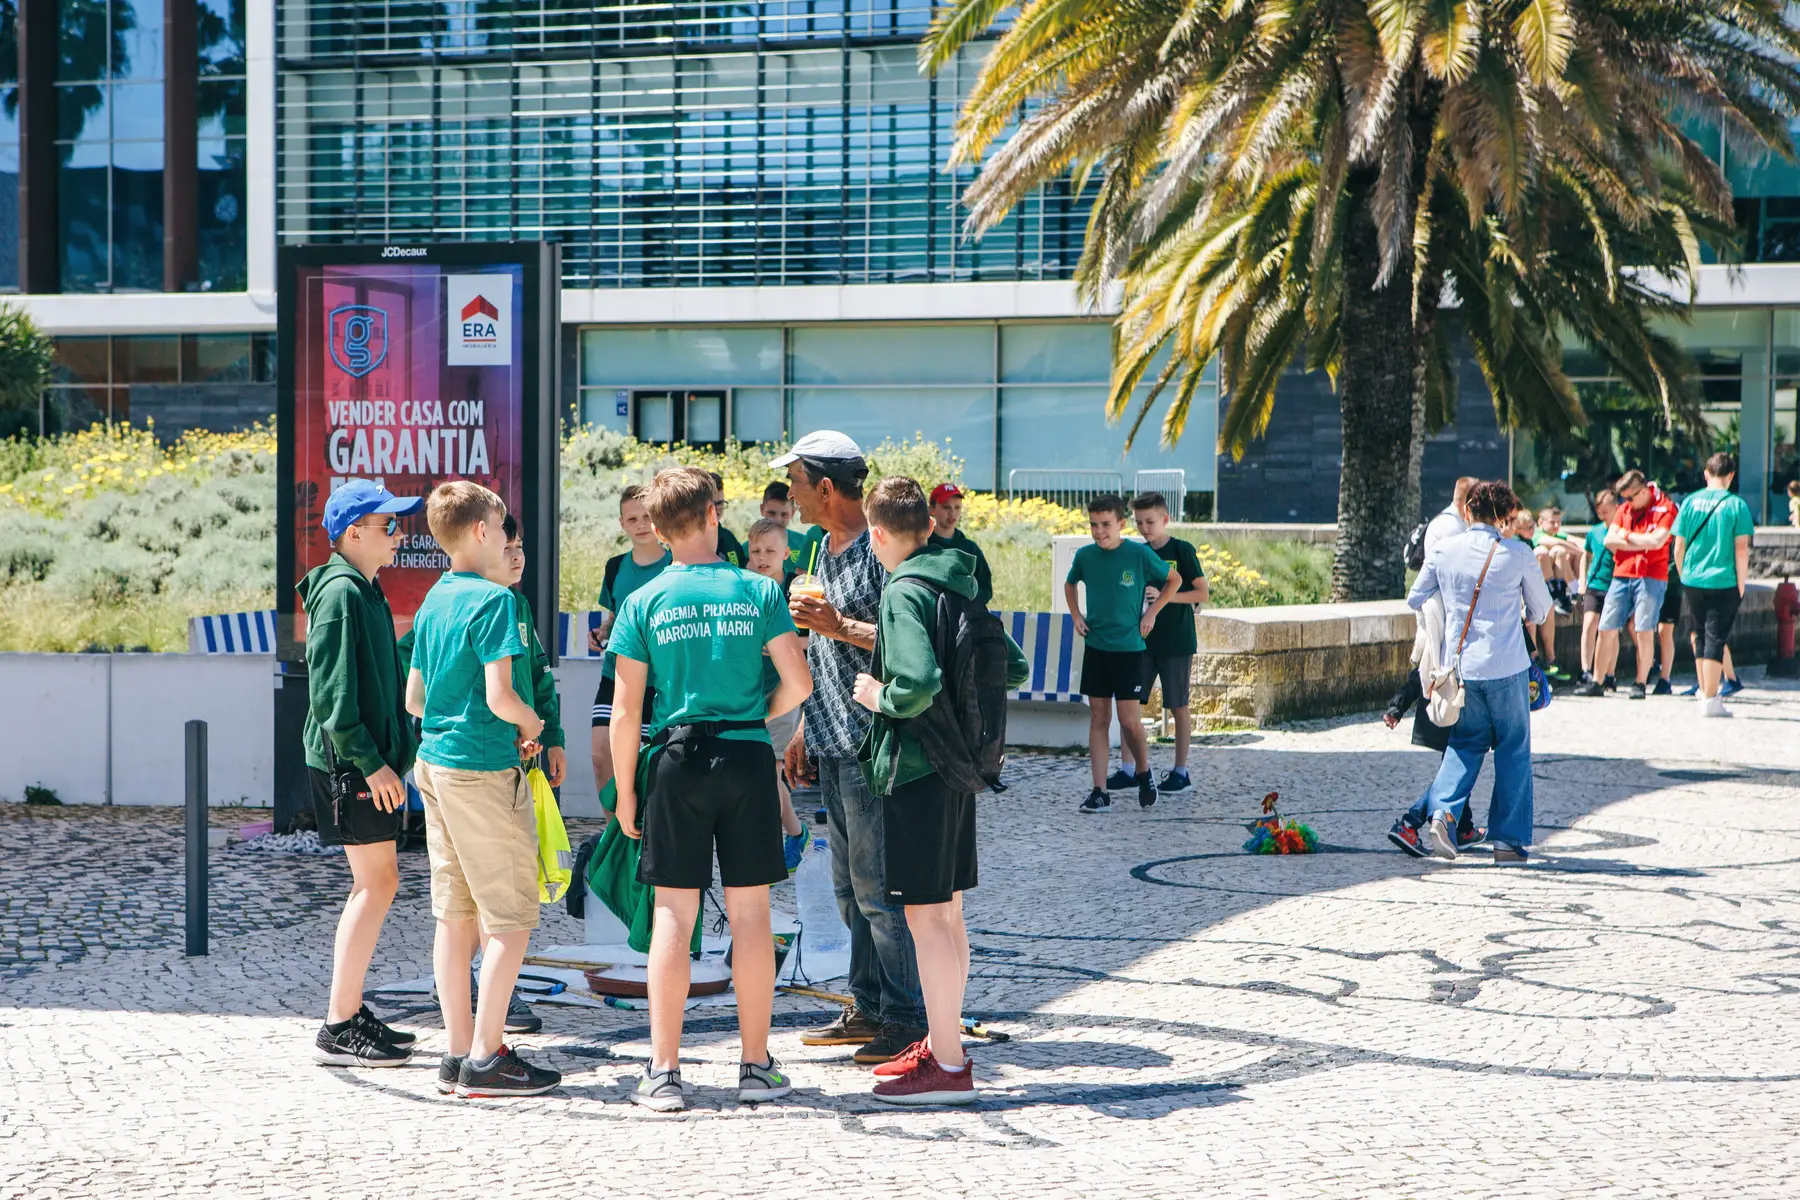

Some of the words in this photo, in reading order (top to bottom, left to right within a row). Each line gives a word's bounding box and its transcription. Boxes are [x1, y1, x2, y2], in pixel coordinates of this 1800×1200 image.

[381, 246, 428, 257] JCDecaux
[463, 323, 497, 337] ERA
[328, 400, 396, 426] VENDER
[400, 400, 445, 426] CASA
[448, 400, 484, 426] COM
[328, 428, 490, 475] GARANTIA
[411, 534, 441, 550] GARA
[400, 550, 452, 568] ENERGÉTIC
[649, 605, 698, 630] AKADEMIA
[703, 602, 760, 617] PIŁKARSKA
[656, 622, 712, 646] MARCOVIA
[717, 620, 754, 636] MARKI
